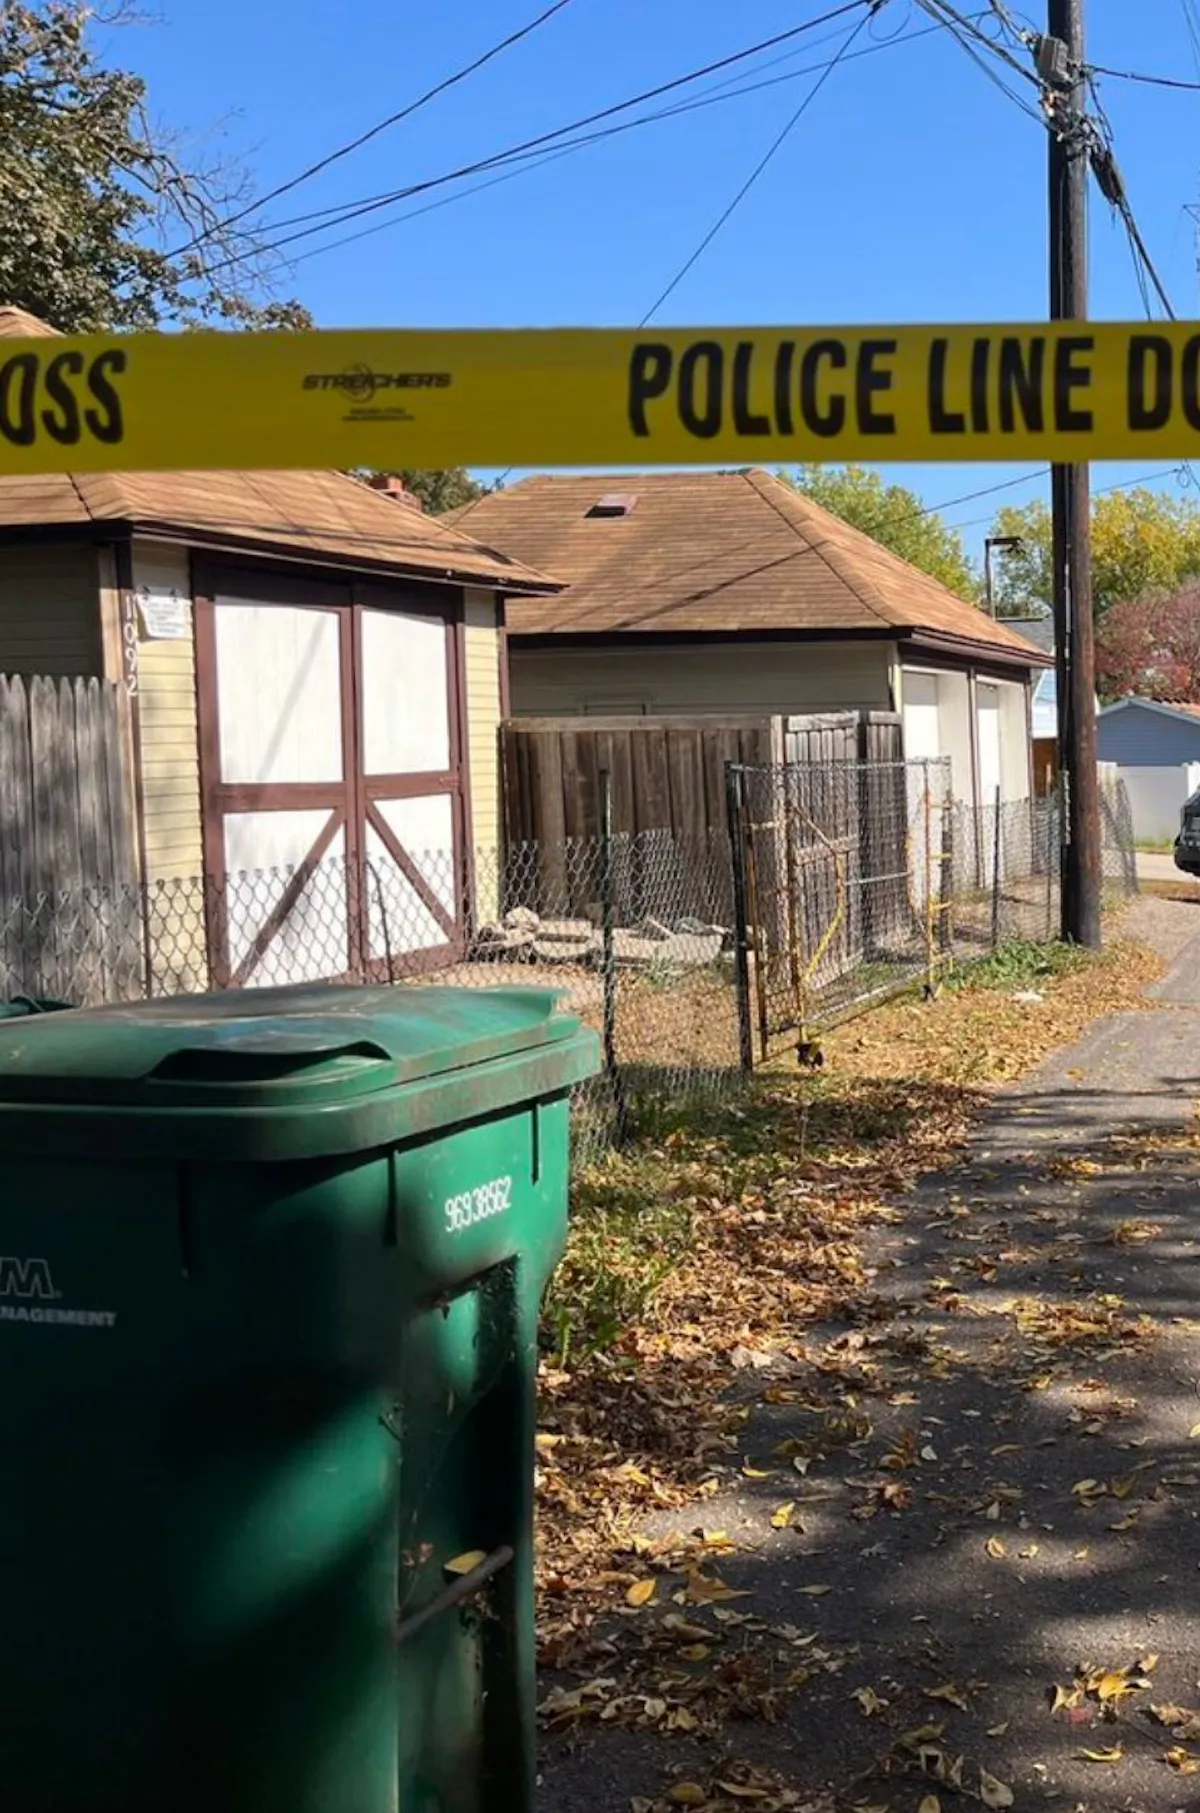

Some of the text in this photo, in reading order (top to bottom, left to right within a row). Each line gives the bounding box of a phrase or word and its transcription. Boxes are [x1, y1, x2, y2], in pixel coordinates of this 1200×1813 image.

[0, 350, 126, 446] OSS
[628, 339, 897, 437] POLICE
[927, 337, 1094, 434] LINE
